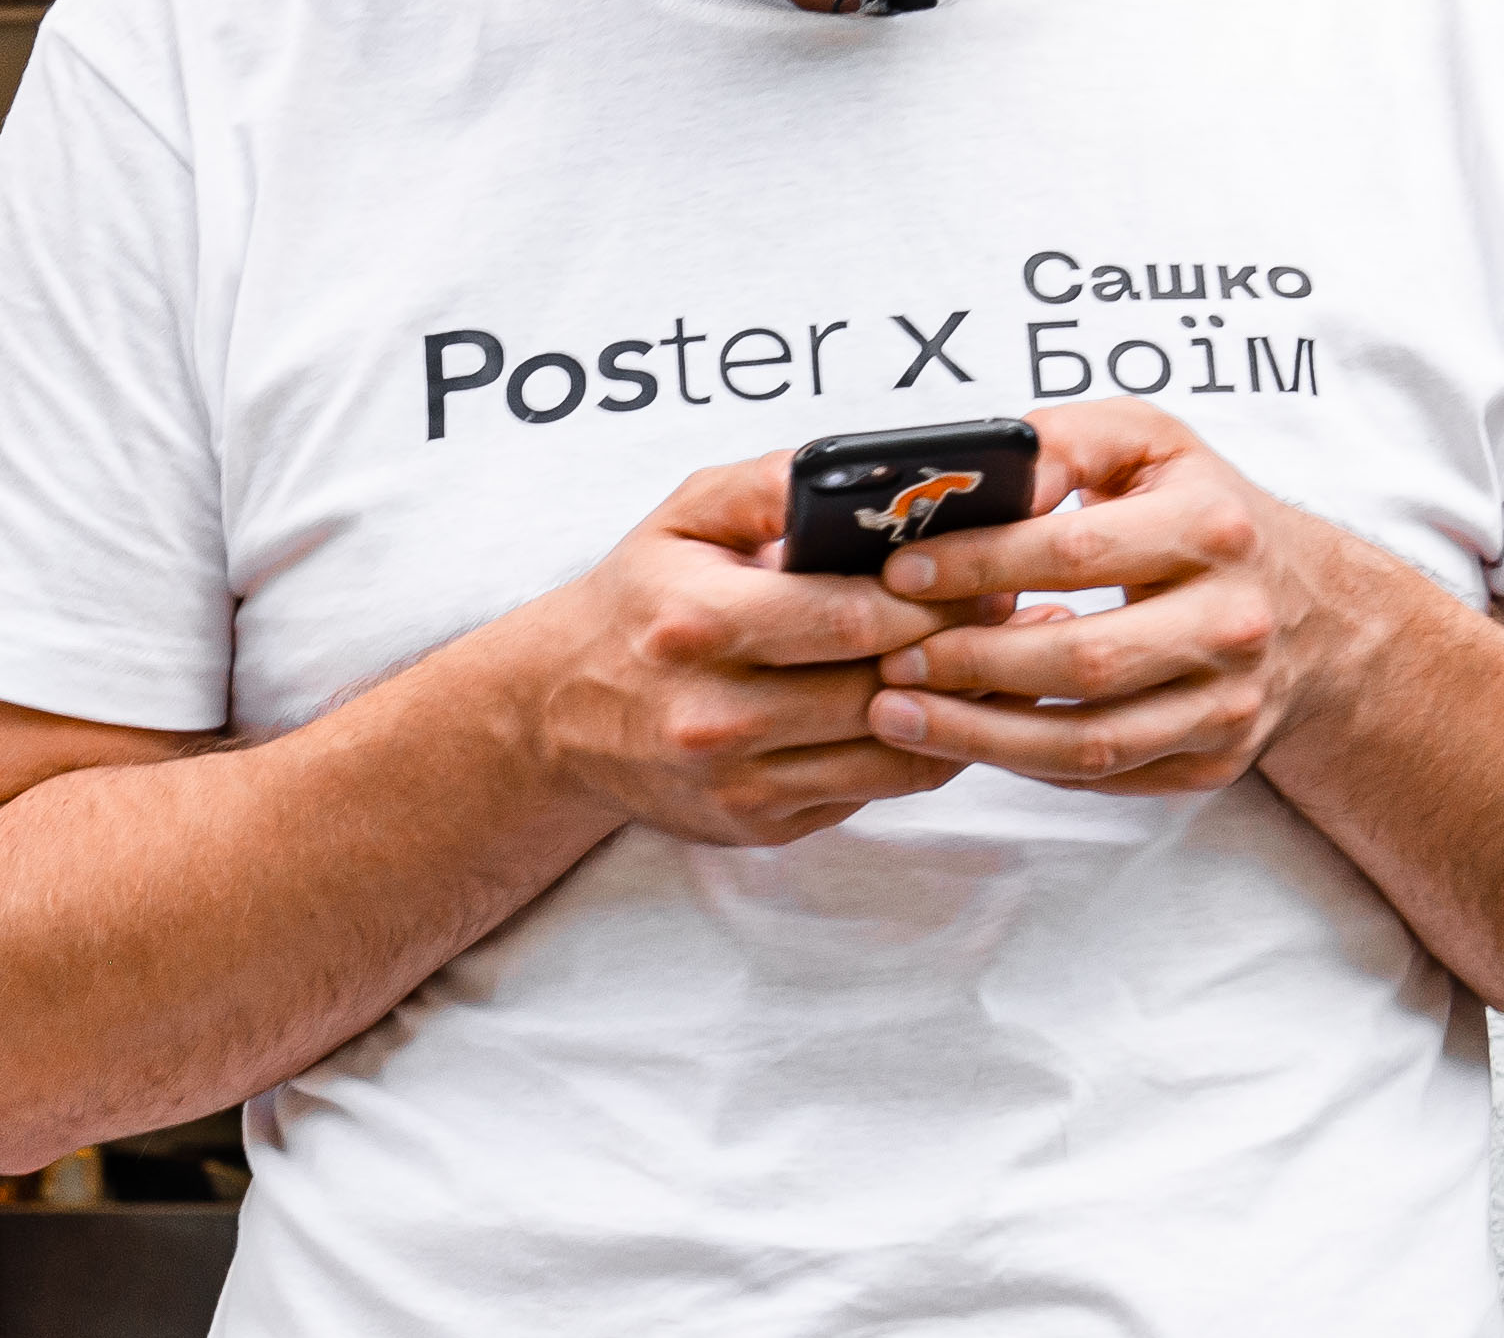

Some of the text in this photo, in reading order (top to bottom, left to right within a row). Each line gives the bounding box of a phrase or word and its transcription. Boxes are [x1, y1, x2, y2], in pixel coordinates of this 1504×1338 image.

[1022, 251, 1313, 306] Сашко
[423, 316, 849, 442] Poster
[1026, 314, 1320, 400] Боїм
